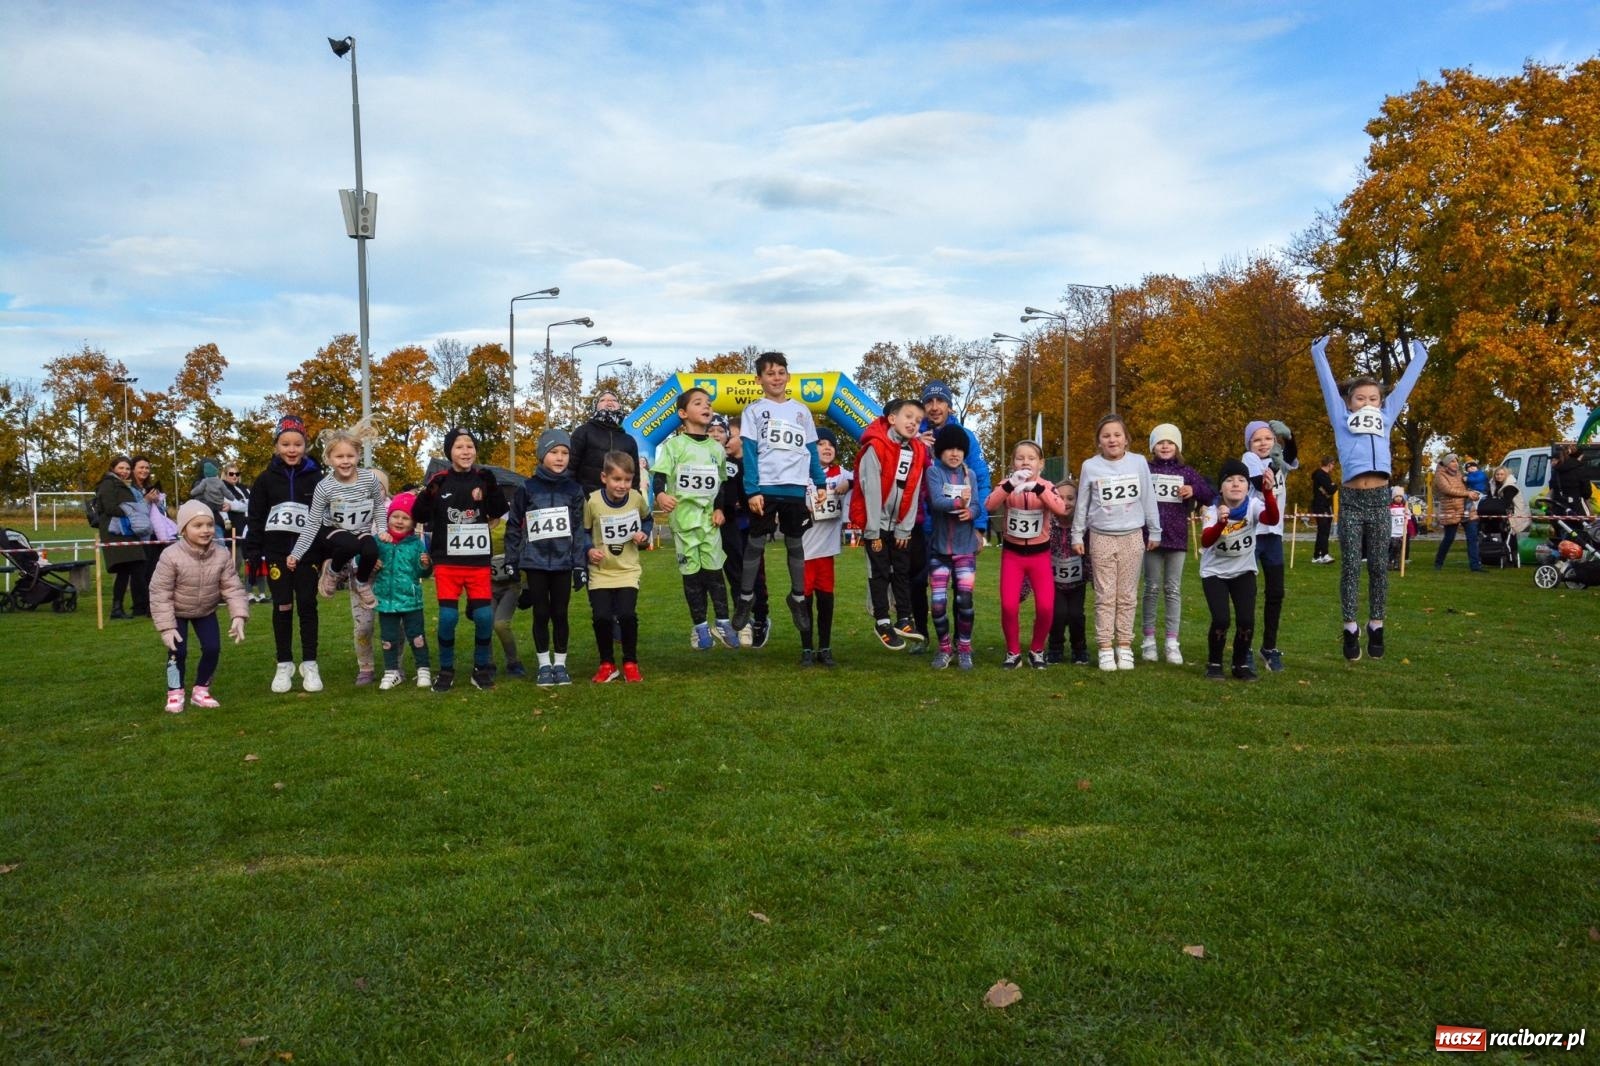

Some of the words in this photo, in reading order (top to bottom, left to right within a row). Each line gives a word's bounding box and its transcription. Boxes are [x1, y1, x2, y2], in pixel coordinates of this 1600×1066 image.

[841, 387, 866, 411] Gmina
[632, 405, 658, 429] Gmina
[656, 387, 678, 408] ludzi
[1349, 415, 1383, 430] 453
[770, 429, 804, 447] 509
[679, 474, 716, 490] 539
[1102, 484, 1139, 500] 523
[269, 511, 306, 528] 436
[333, 510, 371, 525] 517
[530, 517, 567, 534] 448
[1009, 518, 1040, 533] 531
[604, 520, 639, 538] 554
[449, 534, 488, 550] 440
[1216, 535, 1253, 552] 449
